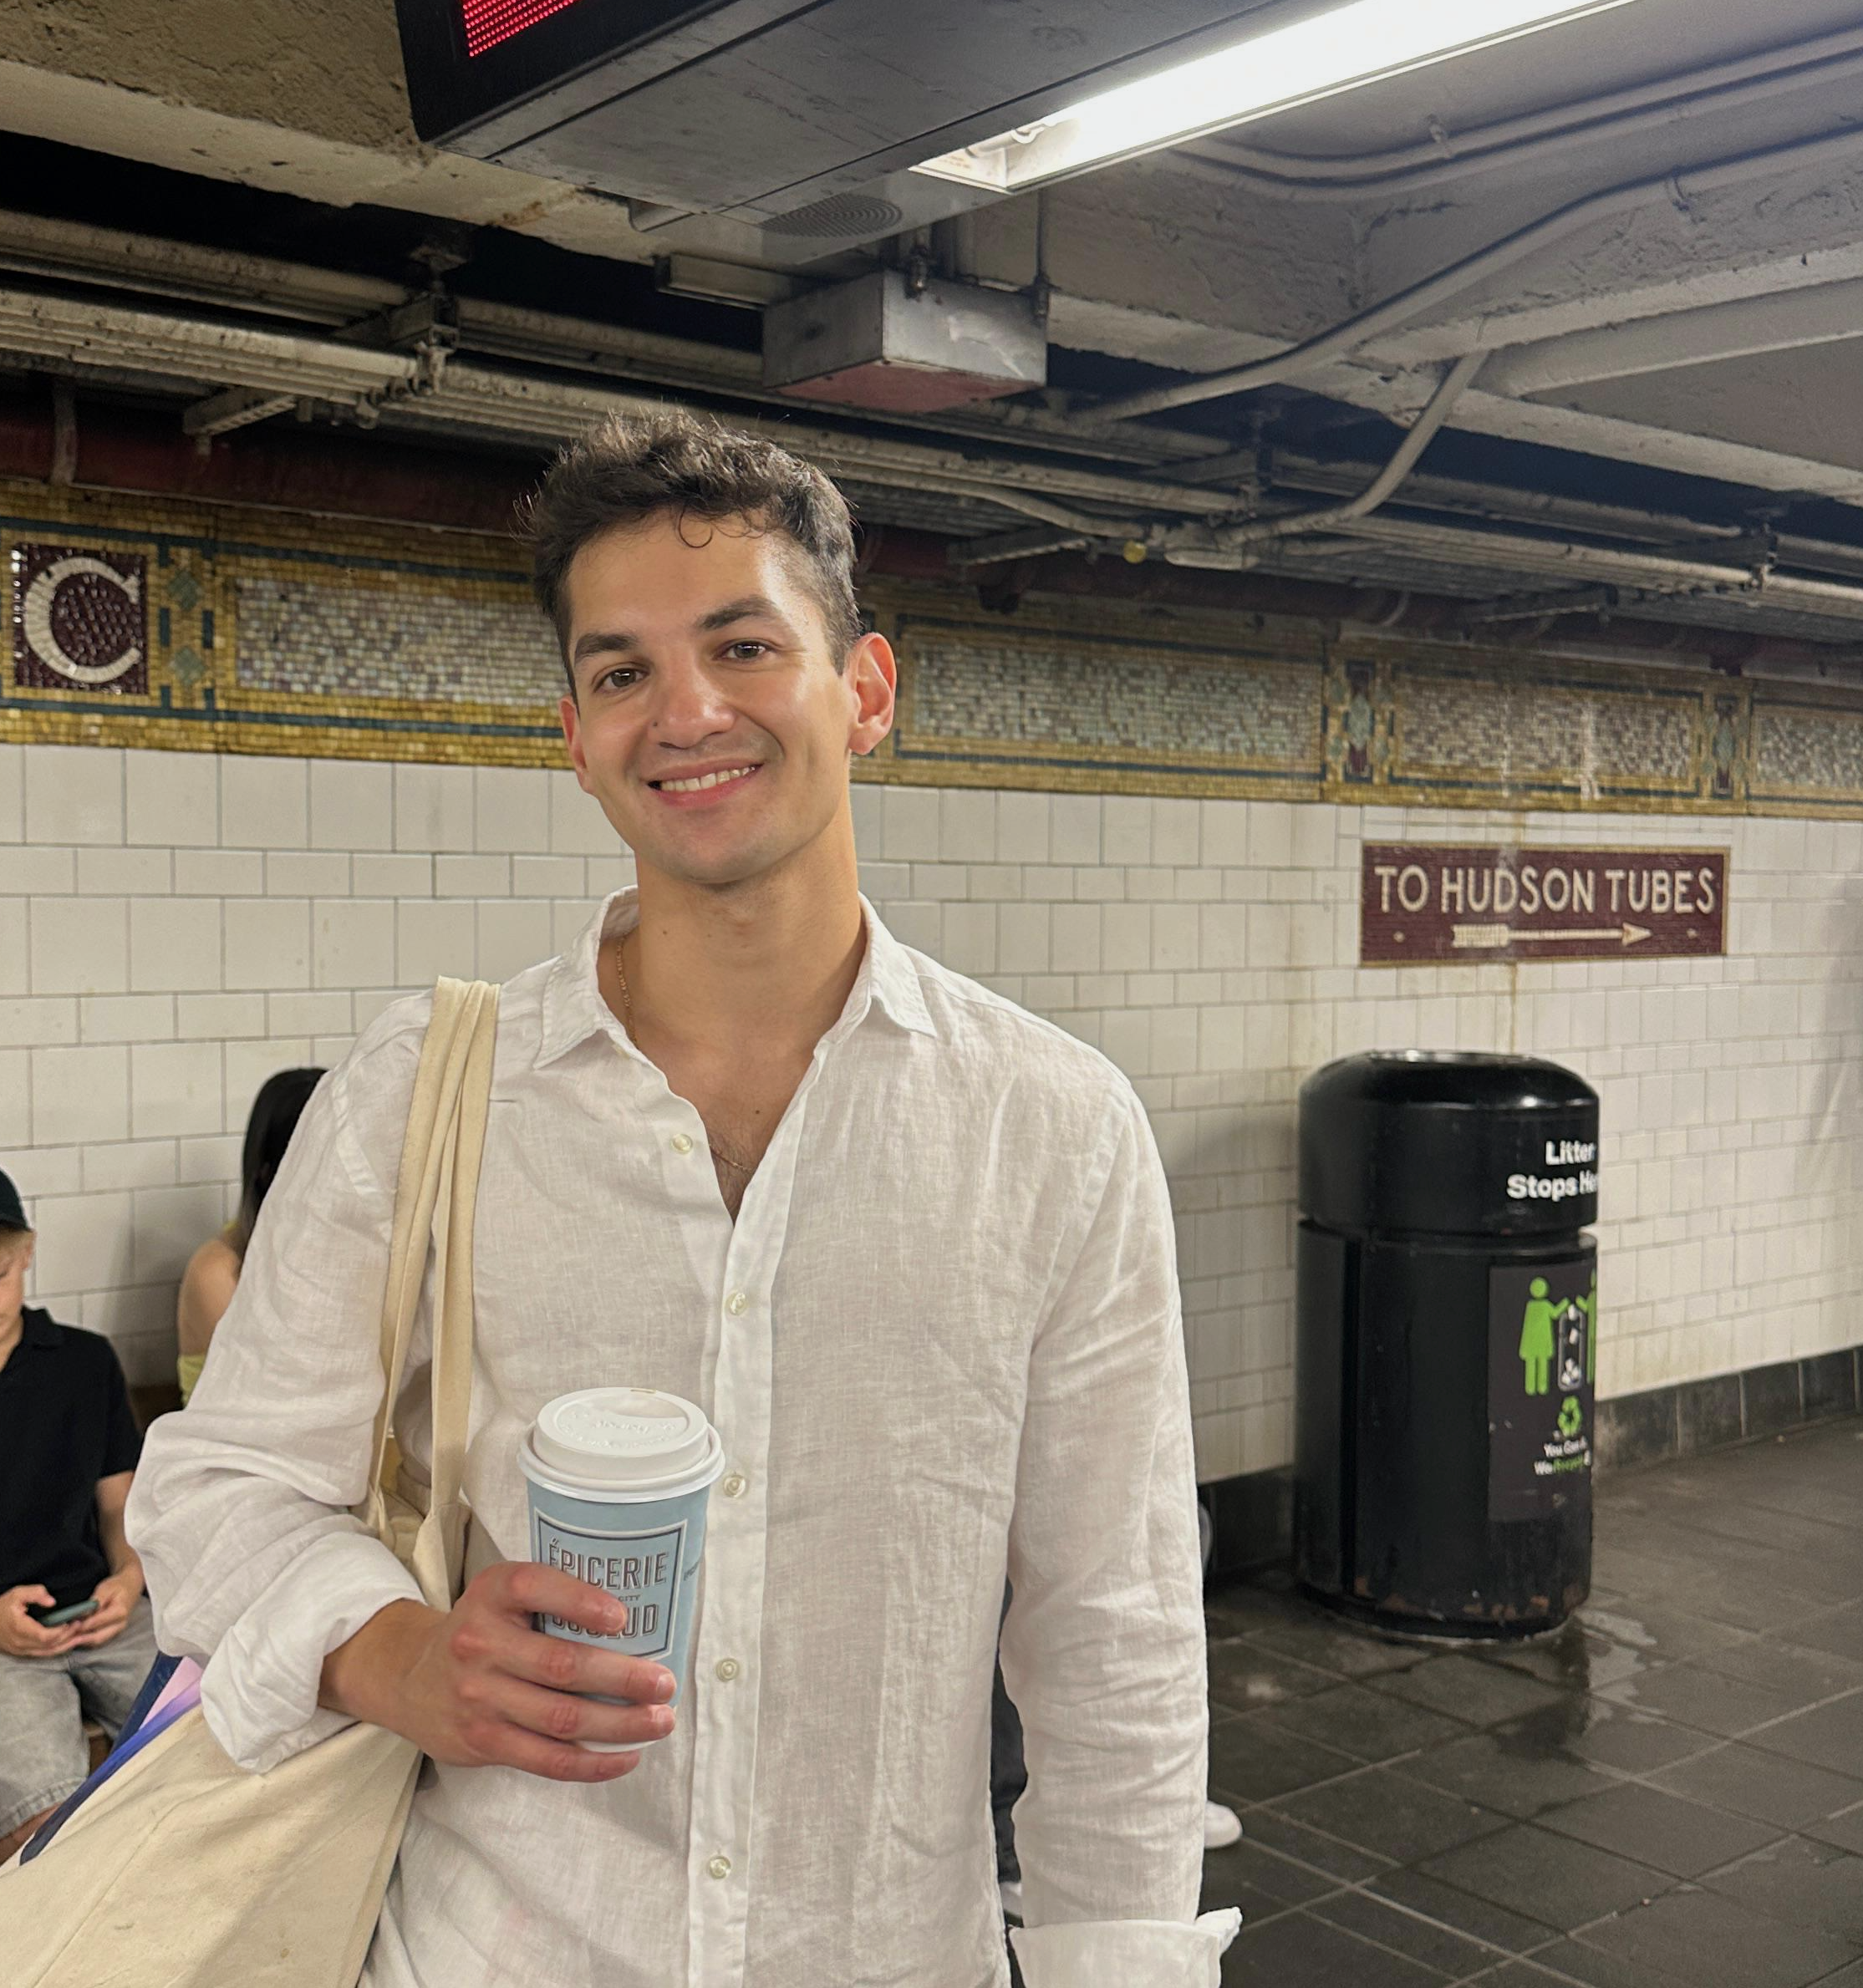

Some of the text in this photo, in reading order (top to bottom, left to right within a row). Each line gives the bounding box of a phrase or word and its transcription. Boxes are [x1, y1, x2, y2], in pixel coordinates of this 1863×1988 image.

[23, 557, 141, 684] C
[1374, 864, 1715, 914] TO HUDSON TUBES
[1545, 1140, 1596, 1166] Litter
[1506, 1173, 1579, 1202] Stops
[548, 1538, 669, 1589] ÉPICERIE
[618, 1594, 641, 1603] CITY
